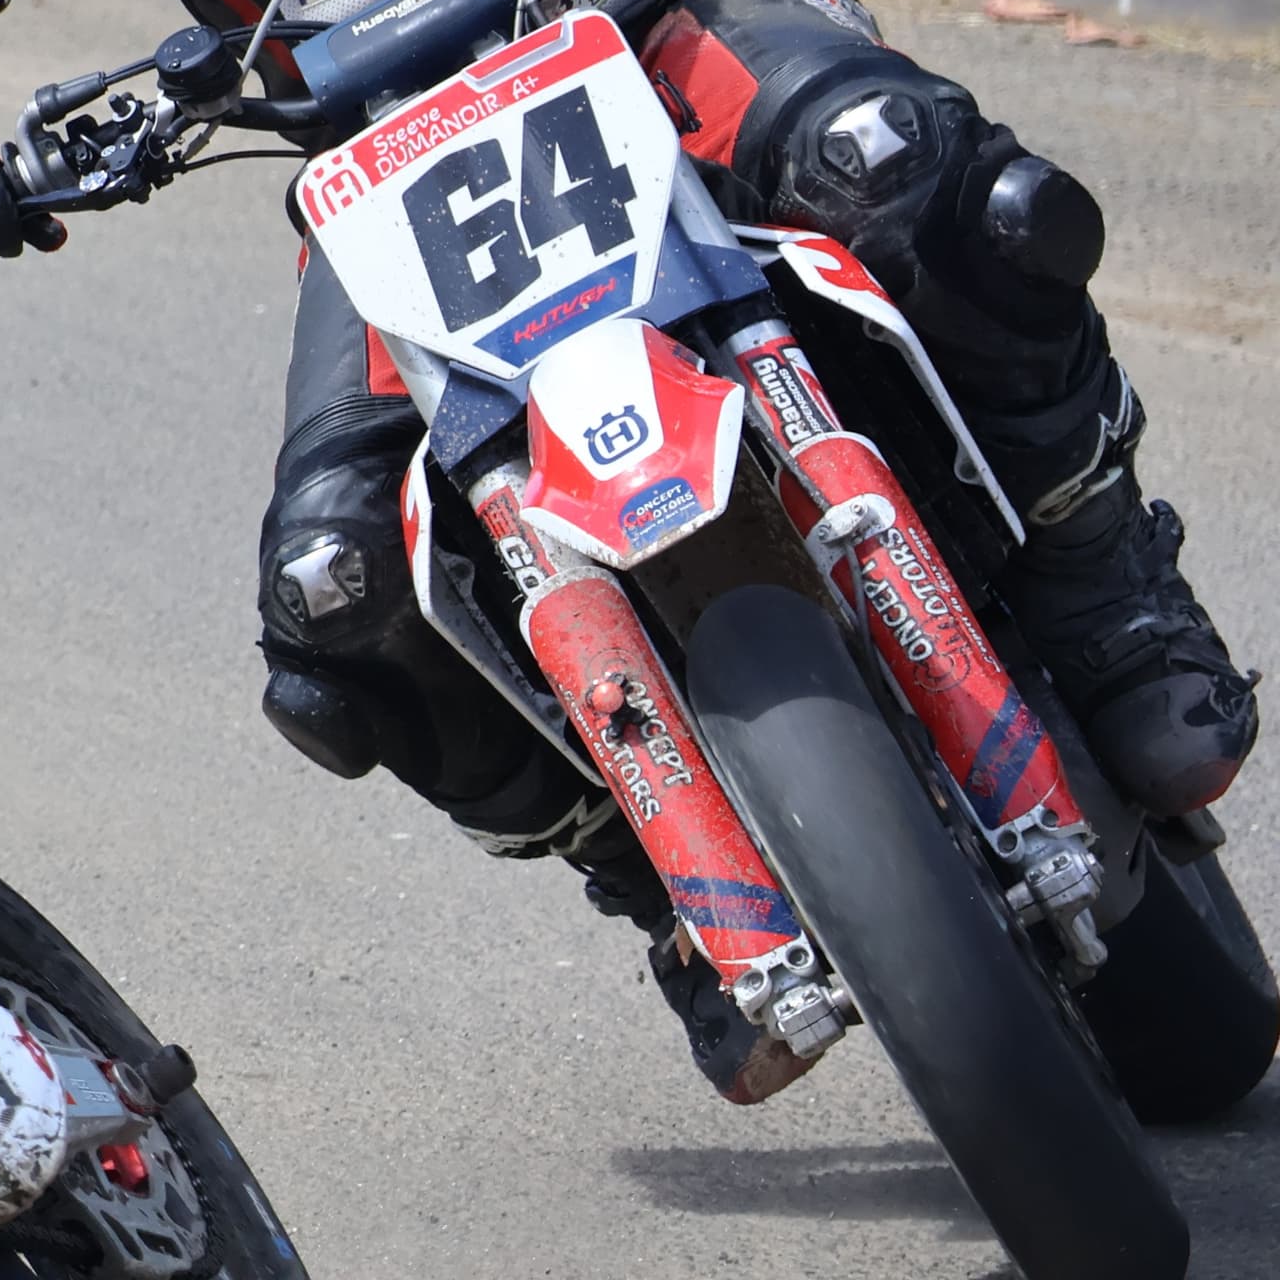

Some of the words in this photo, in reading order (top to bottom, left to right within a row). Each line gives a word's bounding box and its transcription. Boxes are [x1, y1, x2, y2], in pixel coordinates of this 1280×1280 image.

[371, 106, 441, 157] Steeve
[375, 93, 502, 180] DUMANOIR
[511, 74, 540, 101] A+
[401, 83, 638, 334] 64
[752, 356, 813, 444] Racing
